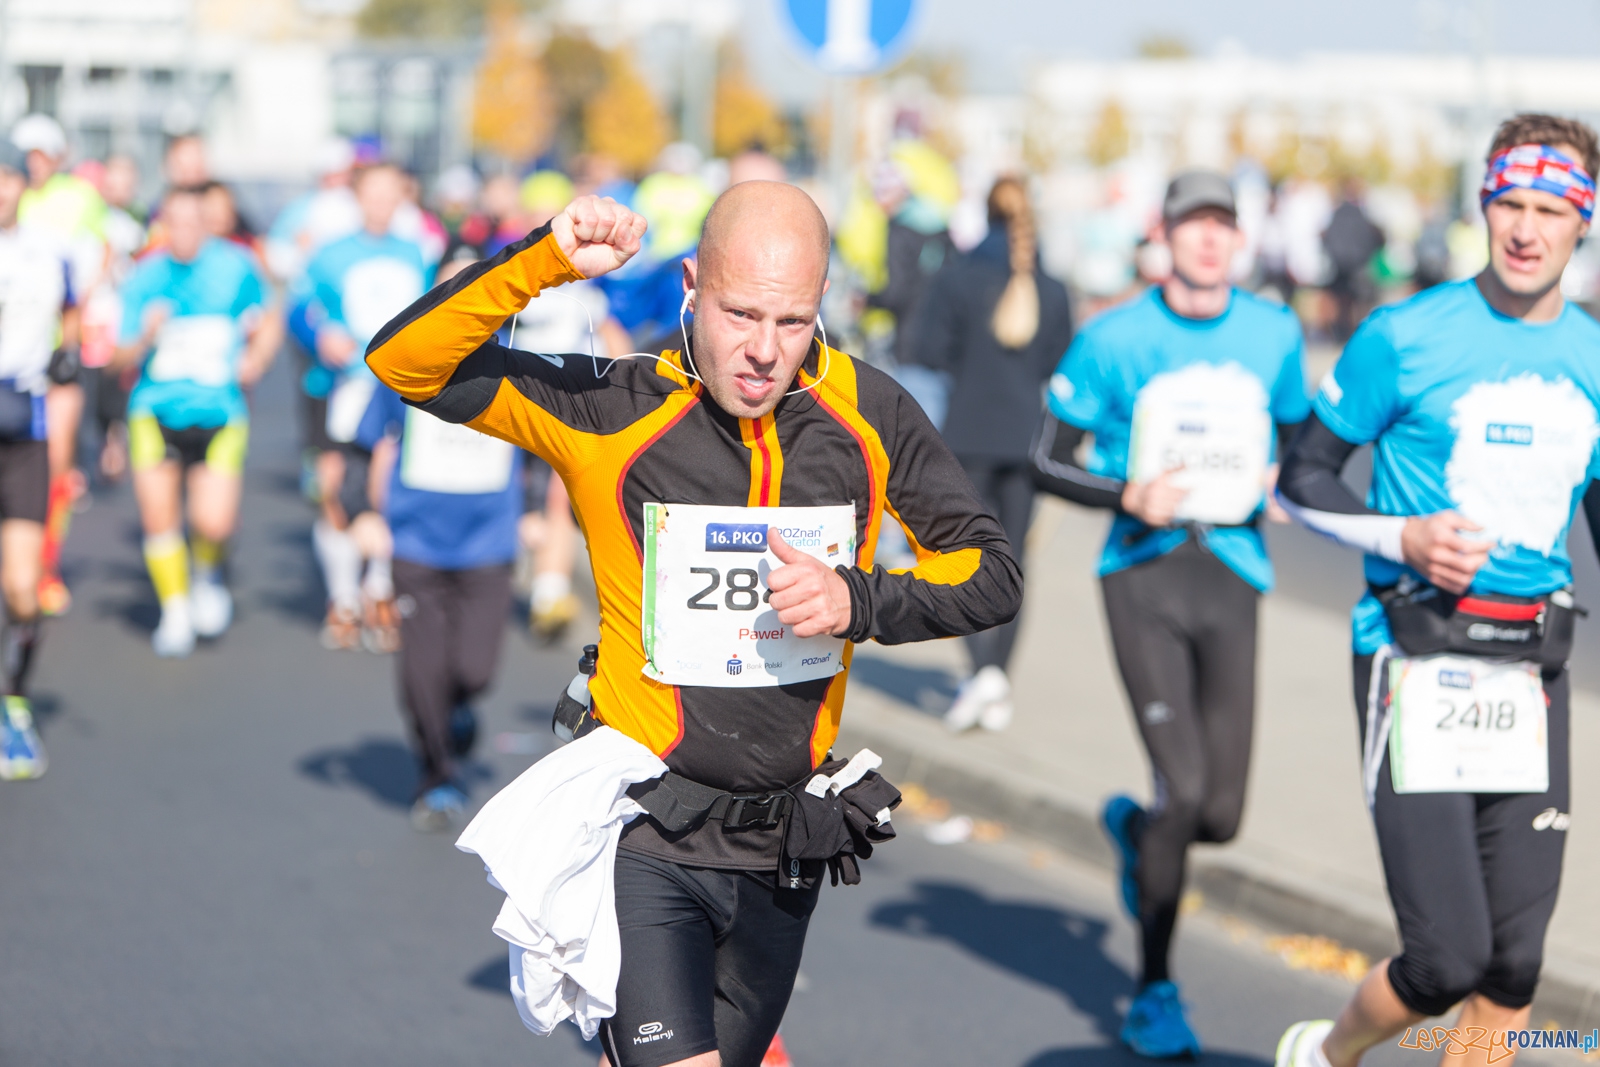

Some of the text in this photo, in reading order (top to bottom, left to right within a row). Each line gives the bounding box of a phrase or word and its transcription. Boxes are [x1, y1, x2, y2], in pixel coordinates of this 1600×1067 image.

[711, 531, 763, 544] 16. PKO
[785, 537, 821, 547] araton
[687, 567, 773, 611] 28
[739, 627, 785, 640] Paweł
[1436, 700, 1516, 730] 2418
[633, 1029, 673, 1045] Kalenji
